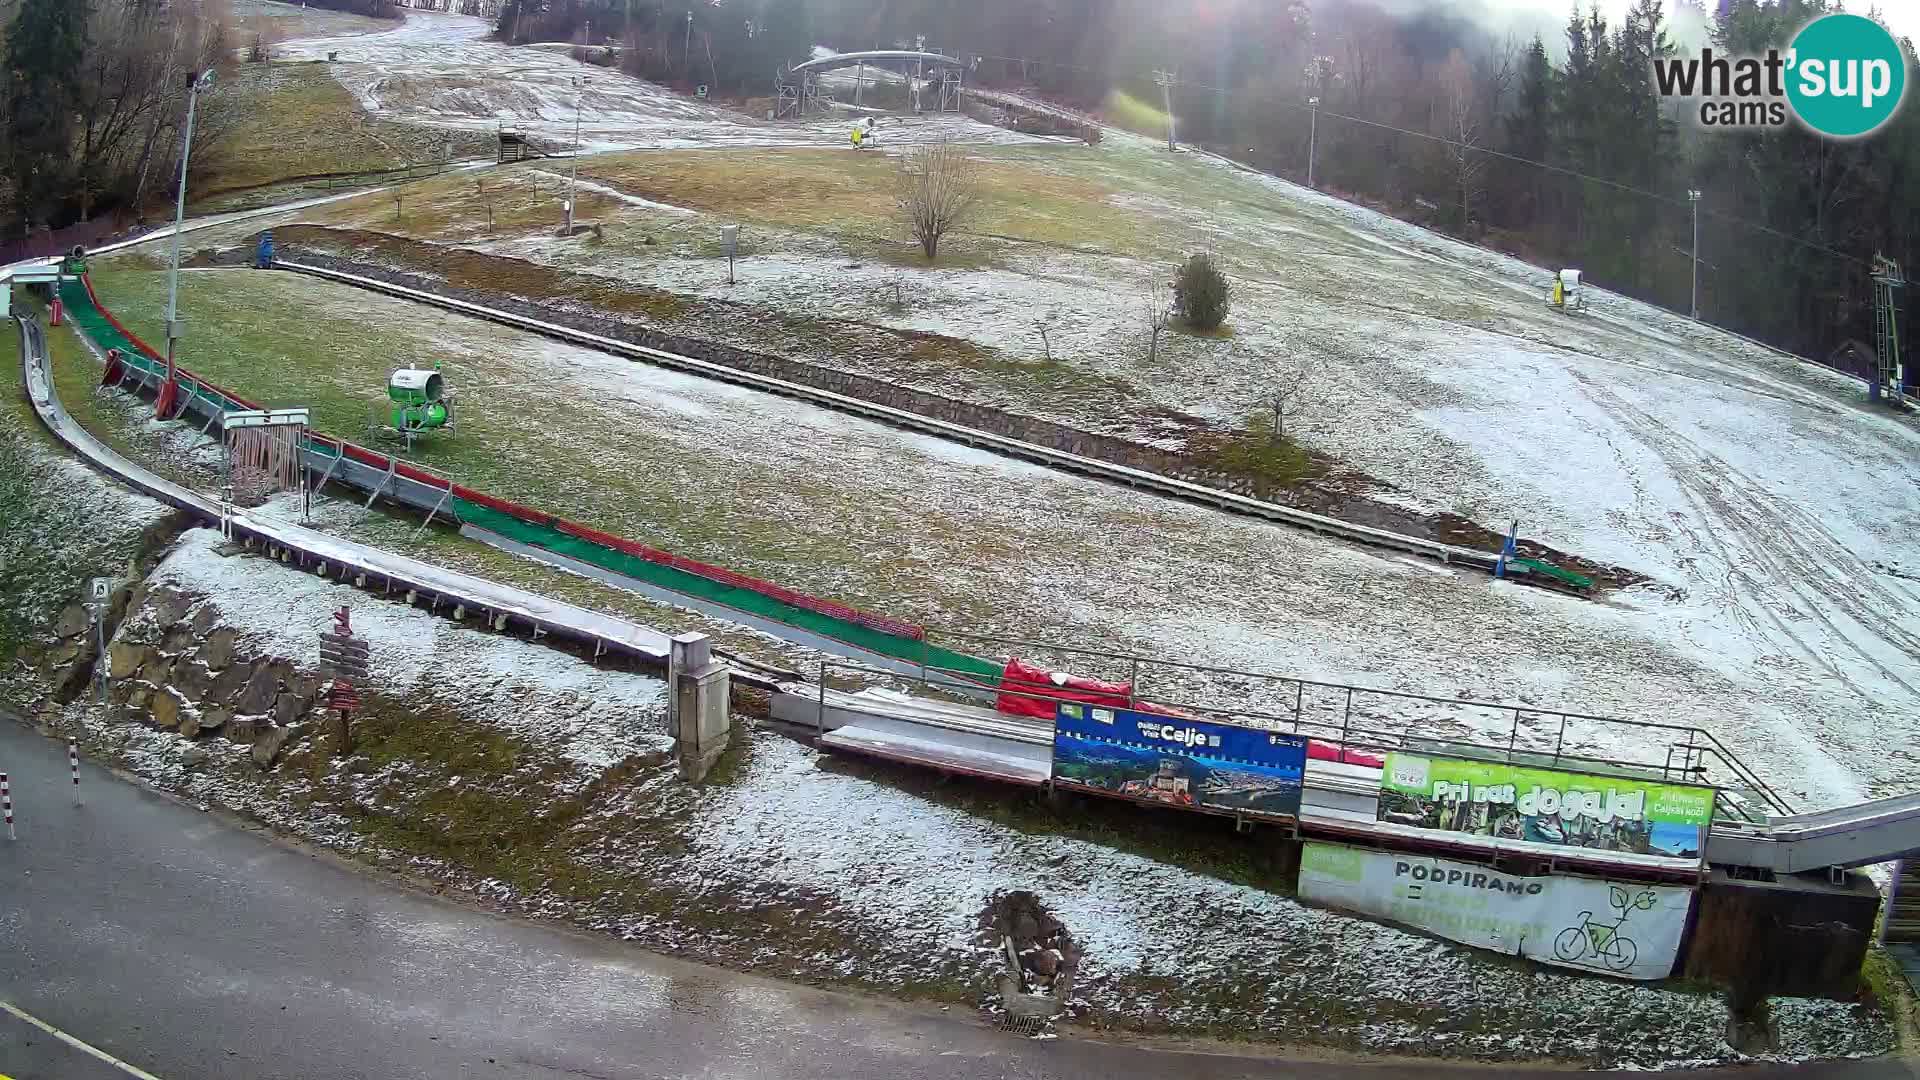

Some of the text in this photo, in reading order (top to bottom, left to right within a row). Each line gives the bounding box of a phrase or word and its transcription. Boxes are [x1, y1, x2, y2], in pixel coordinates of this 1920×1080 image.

[1161, 725, 1206, 747] Celje
[1432, 780, 1469, 802] Pri
[1473, 783, 1516, 804] nas
[1395, 861, 1543, 895] PODPIRAMO
